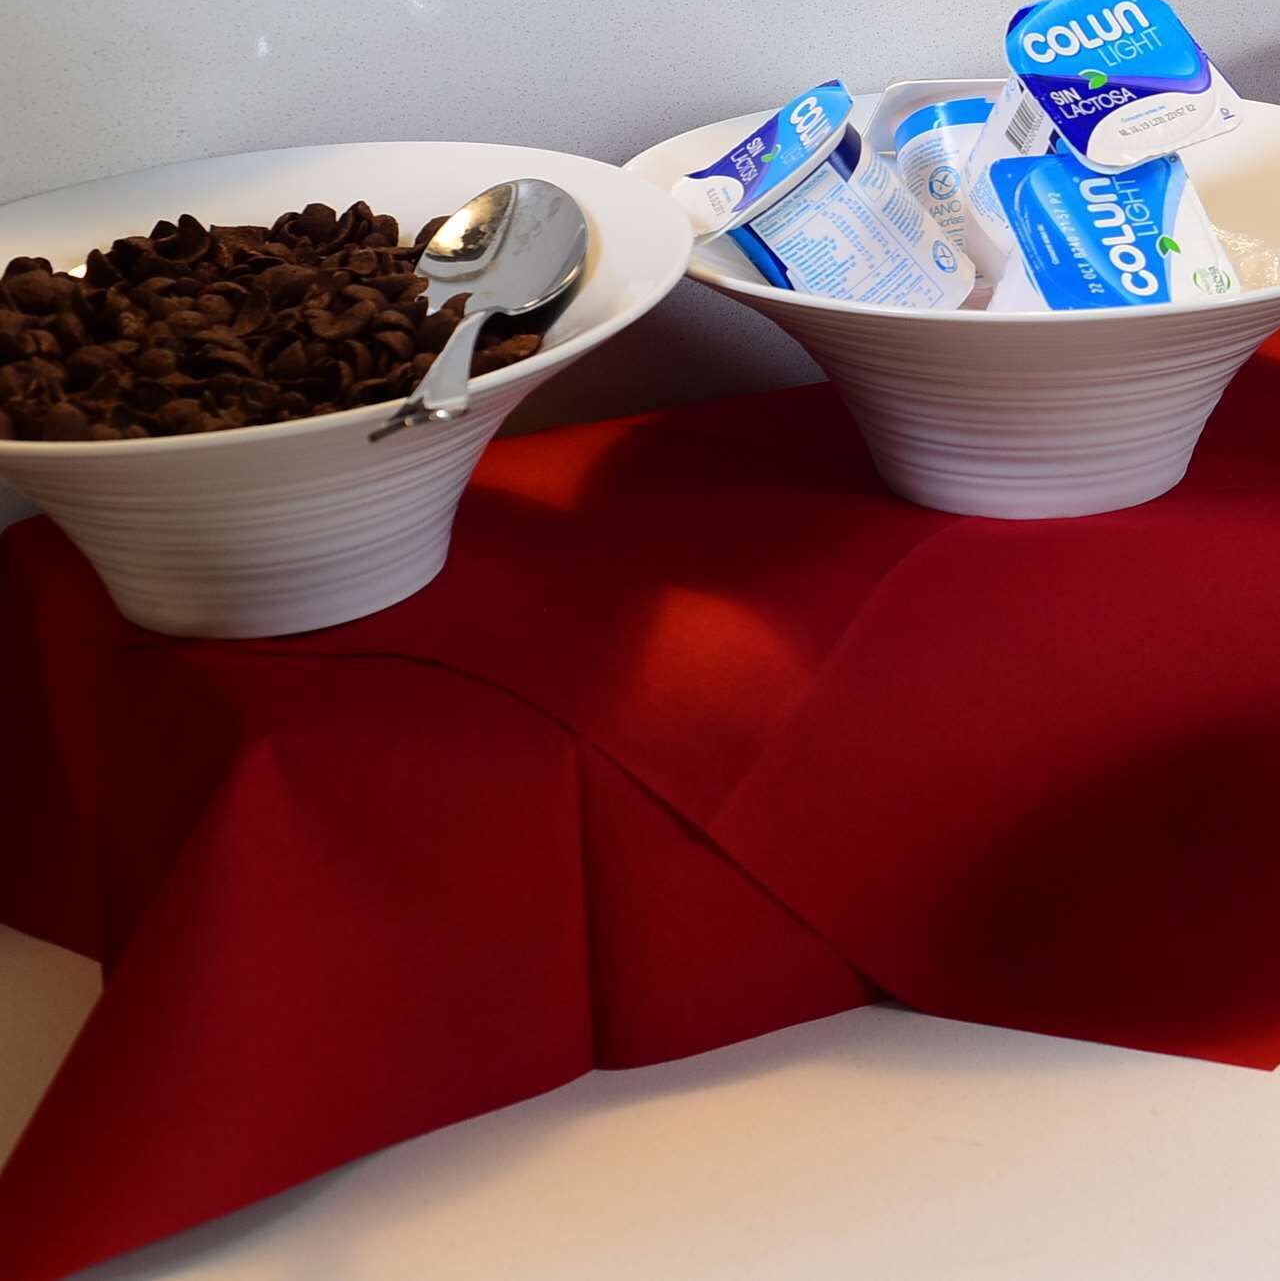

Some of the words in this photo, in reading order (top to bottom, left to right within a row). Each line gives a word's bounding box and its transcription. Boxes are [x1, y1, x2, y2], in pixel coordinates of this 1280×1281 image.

[1098, 26, 1163, 67] LIGHT
[1050, 87, 1082, 106] SIN
[1058, 87, 1136, 119] LACTOSA
[1078, 263, 1097, 280] OCT
